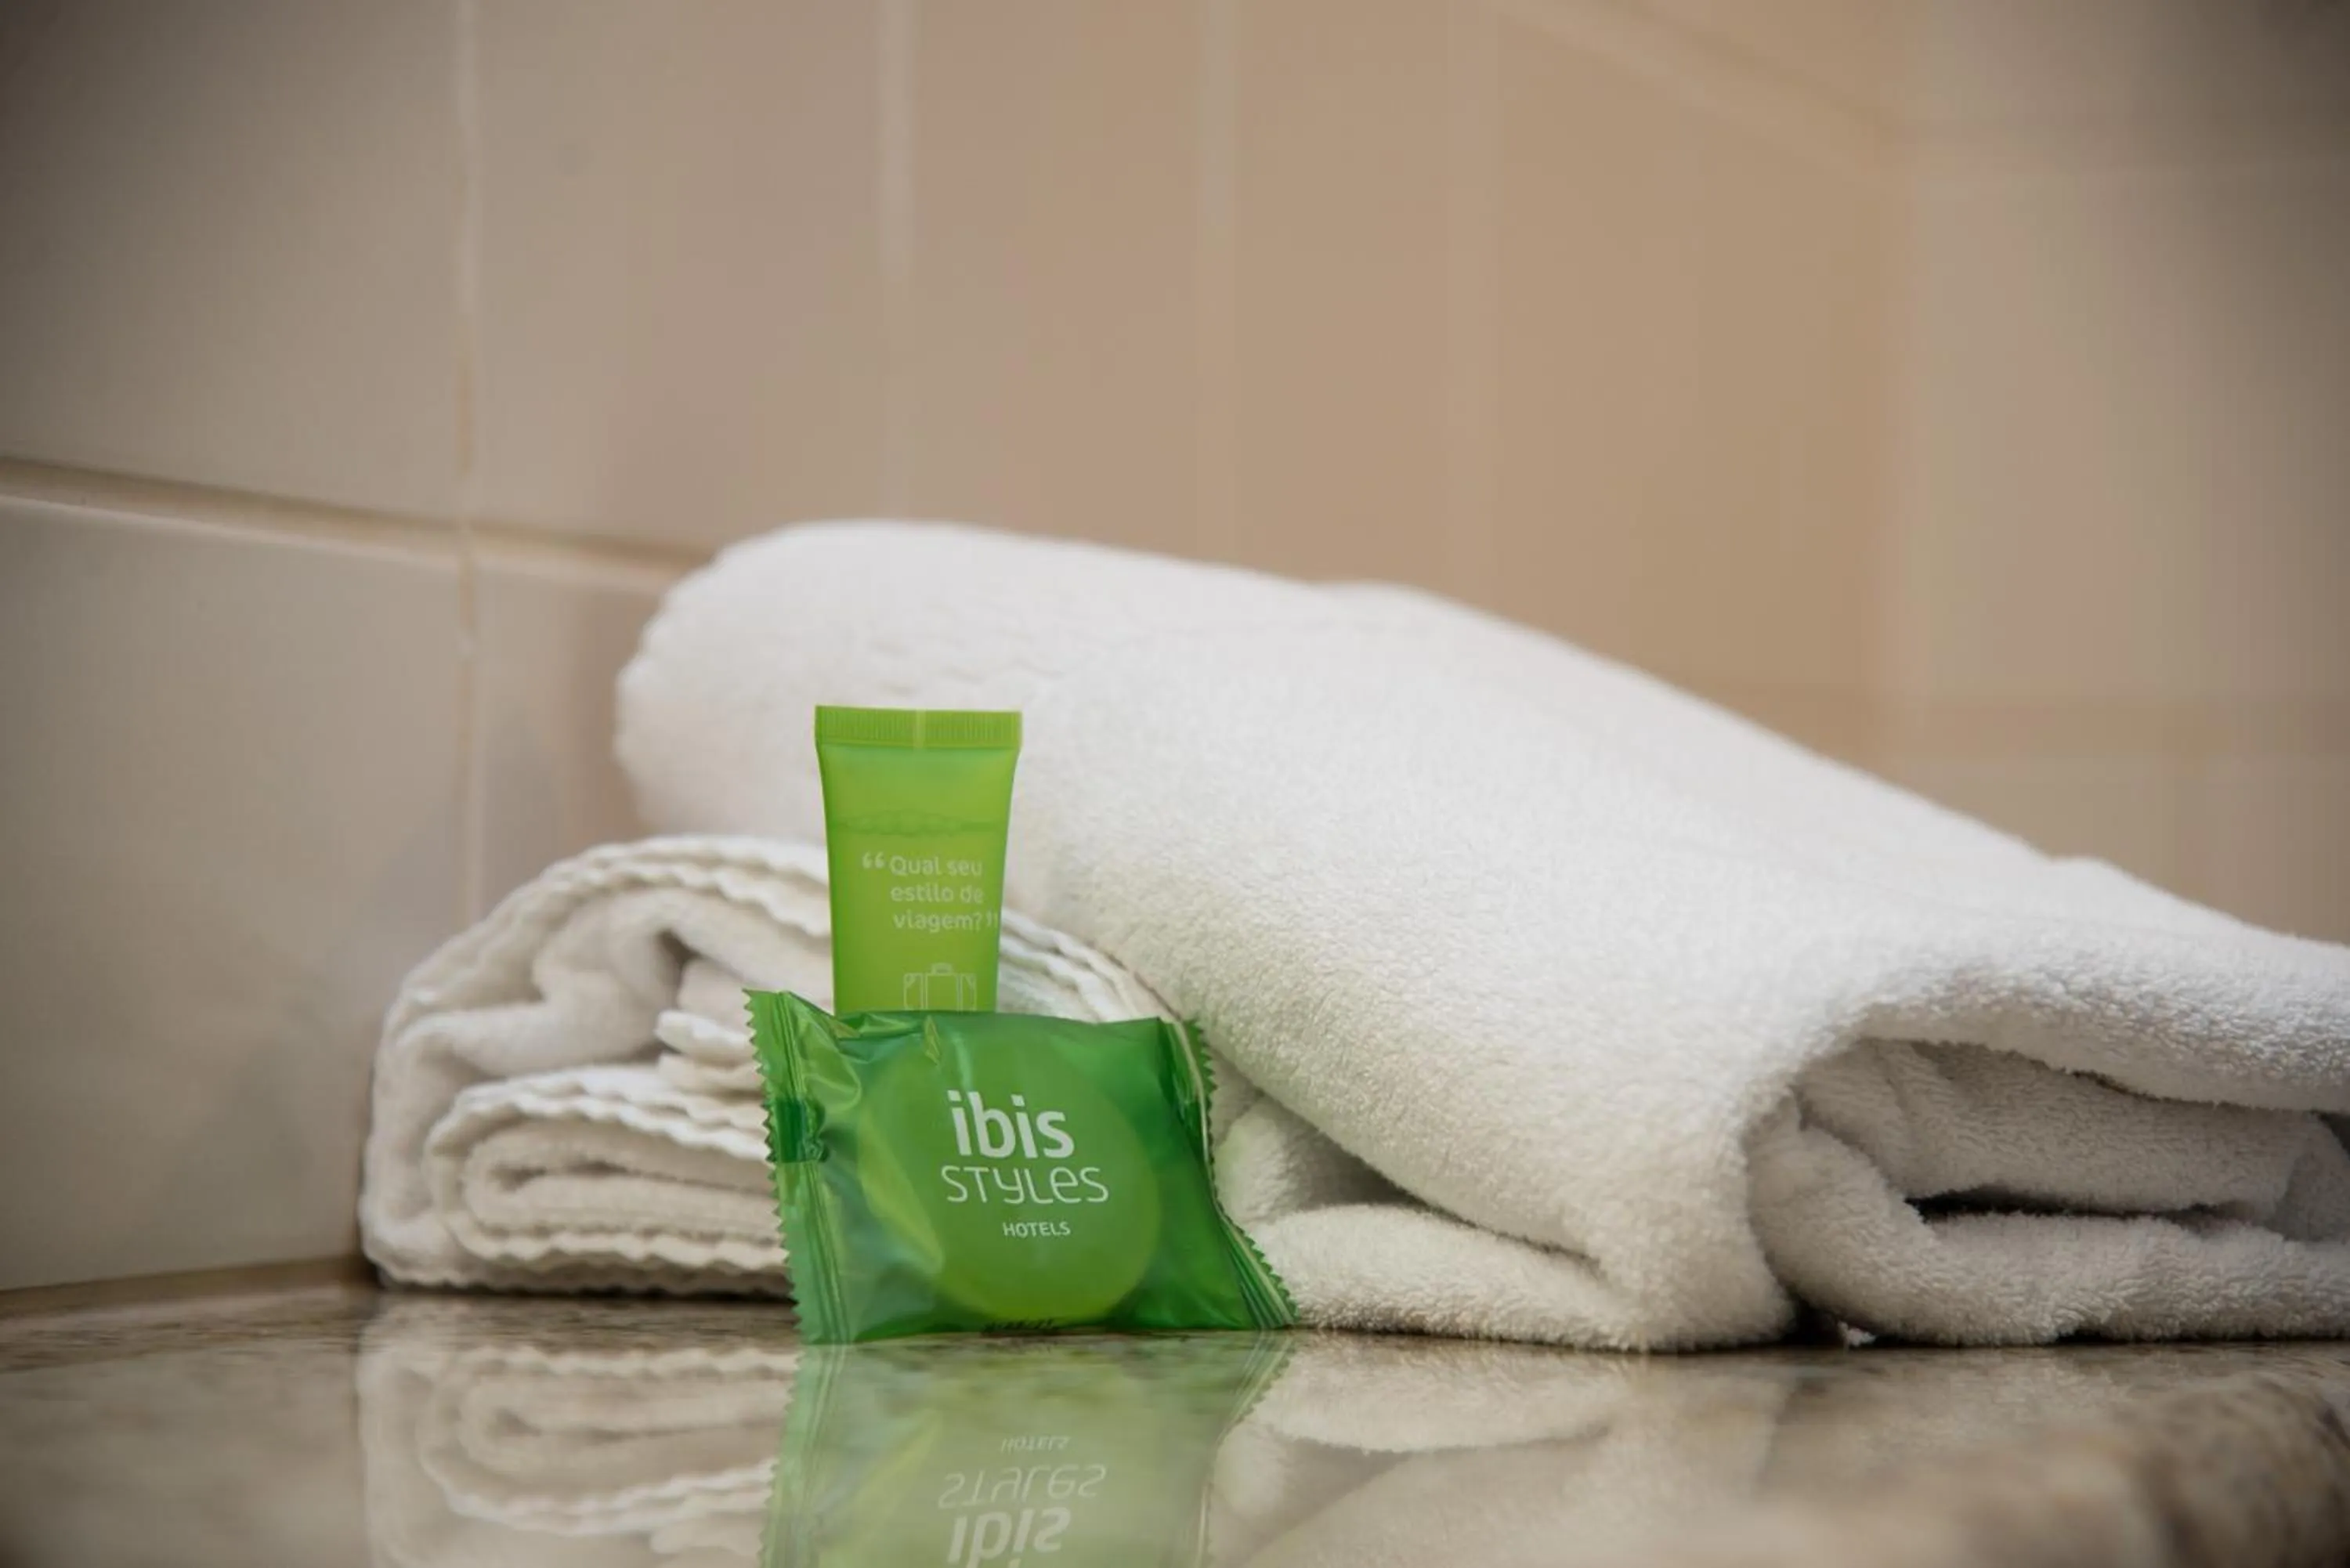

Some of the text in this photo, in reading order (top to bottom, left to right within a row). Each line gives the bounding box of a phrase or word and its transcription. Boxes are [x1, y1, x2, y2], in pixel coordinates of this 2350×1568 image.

[946, 859, 982, 876] seu
[890, 883, 984, 903] estilo de
[947, 1089, 1075, 1158] ibis
[1003, 1222, 1071, 1238] HOTELS
